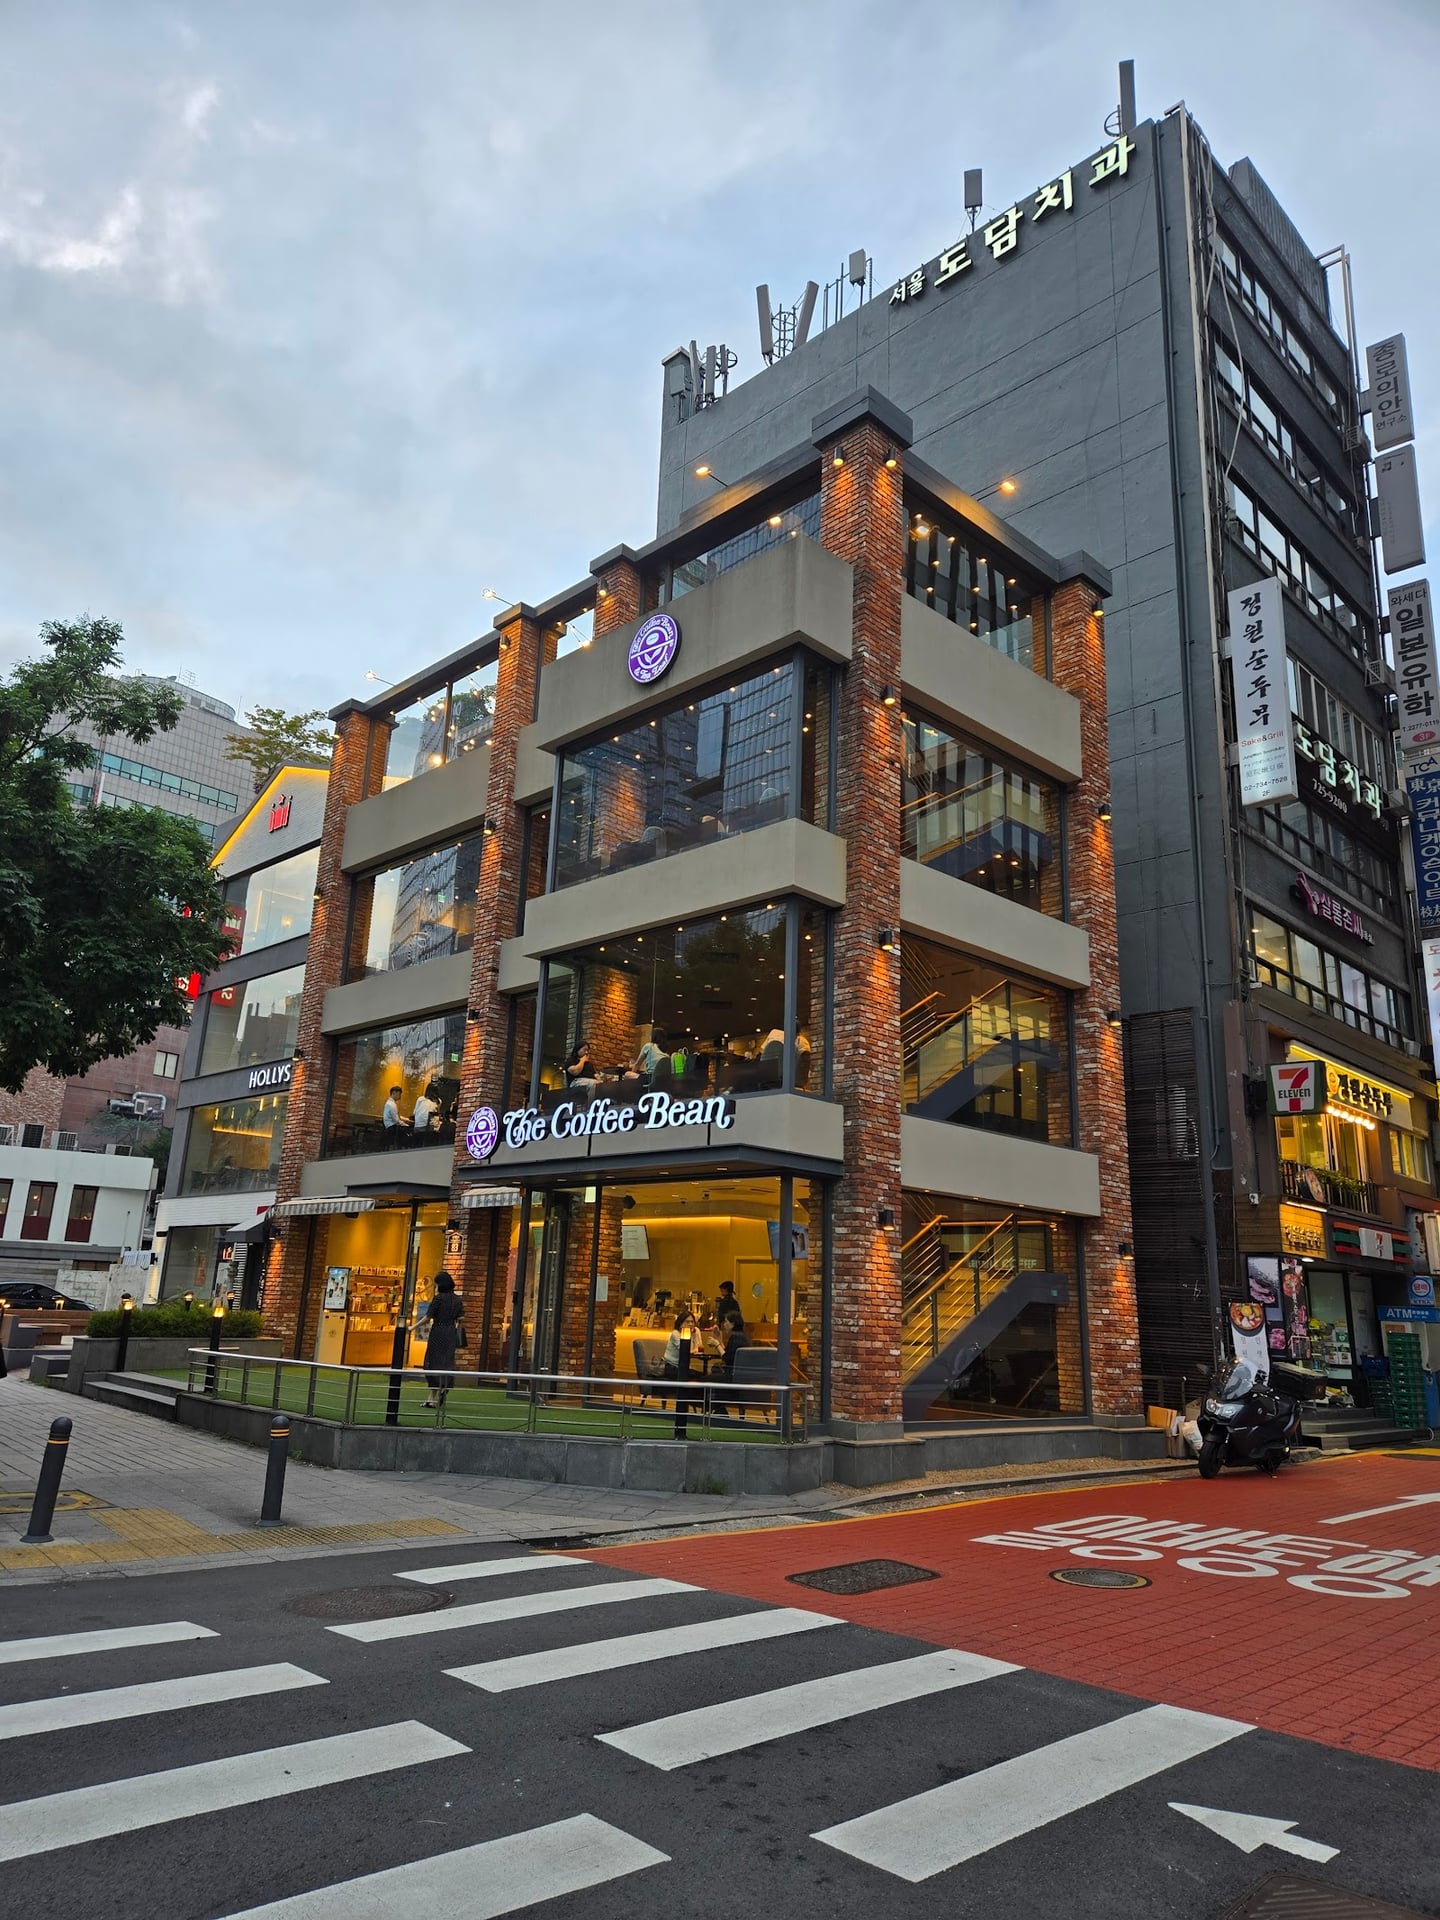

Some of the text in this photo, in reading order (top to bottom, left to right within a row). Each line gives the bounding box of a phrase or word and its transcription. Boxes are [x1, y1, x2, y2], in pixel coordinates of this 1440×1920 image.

[888, 135, 1136, 305] 서울 도담치과
[1373, 340, 1403, 418] 종로의안
[1376, 414, 1407, 431] 연구소
[1391, 588, 1427, 606] 와세다
[1240, 592, 1273, 727] 정원순두부
[1395, 603, 1435, 717] 일본유학
[1241, 731, 1284, 748] Sake&Grill
[1294, 720, 1383, 819] 도담치과
[1409, 756, 1438, 774] TCA
[249, 1063, 291, 1089] HOLLYS
[503, 1092, 732, 1149] The Coffee Bean
[1386, 1308, 1412, 1319] ATM
